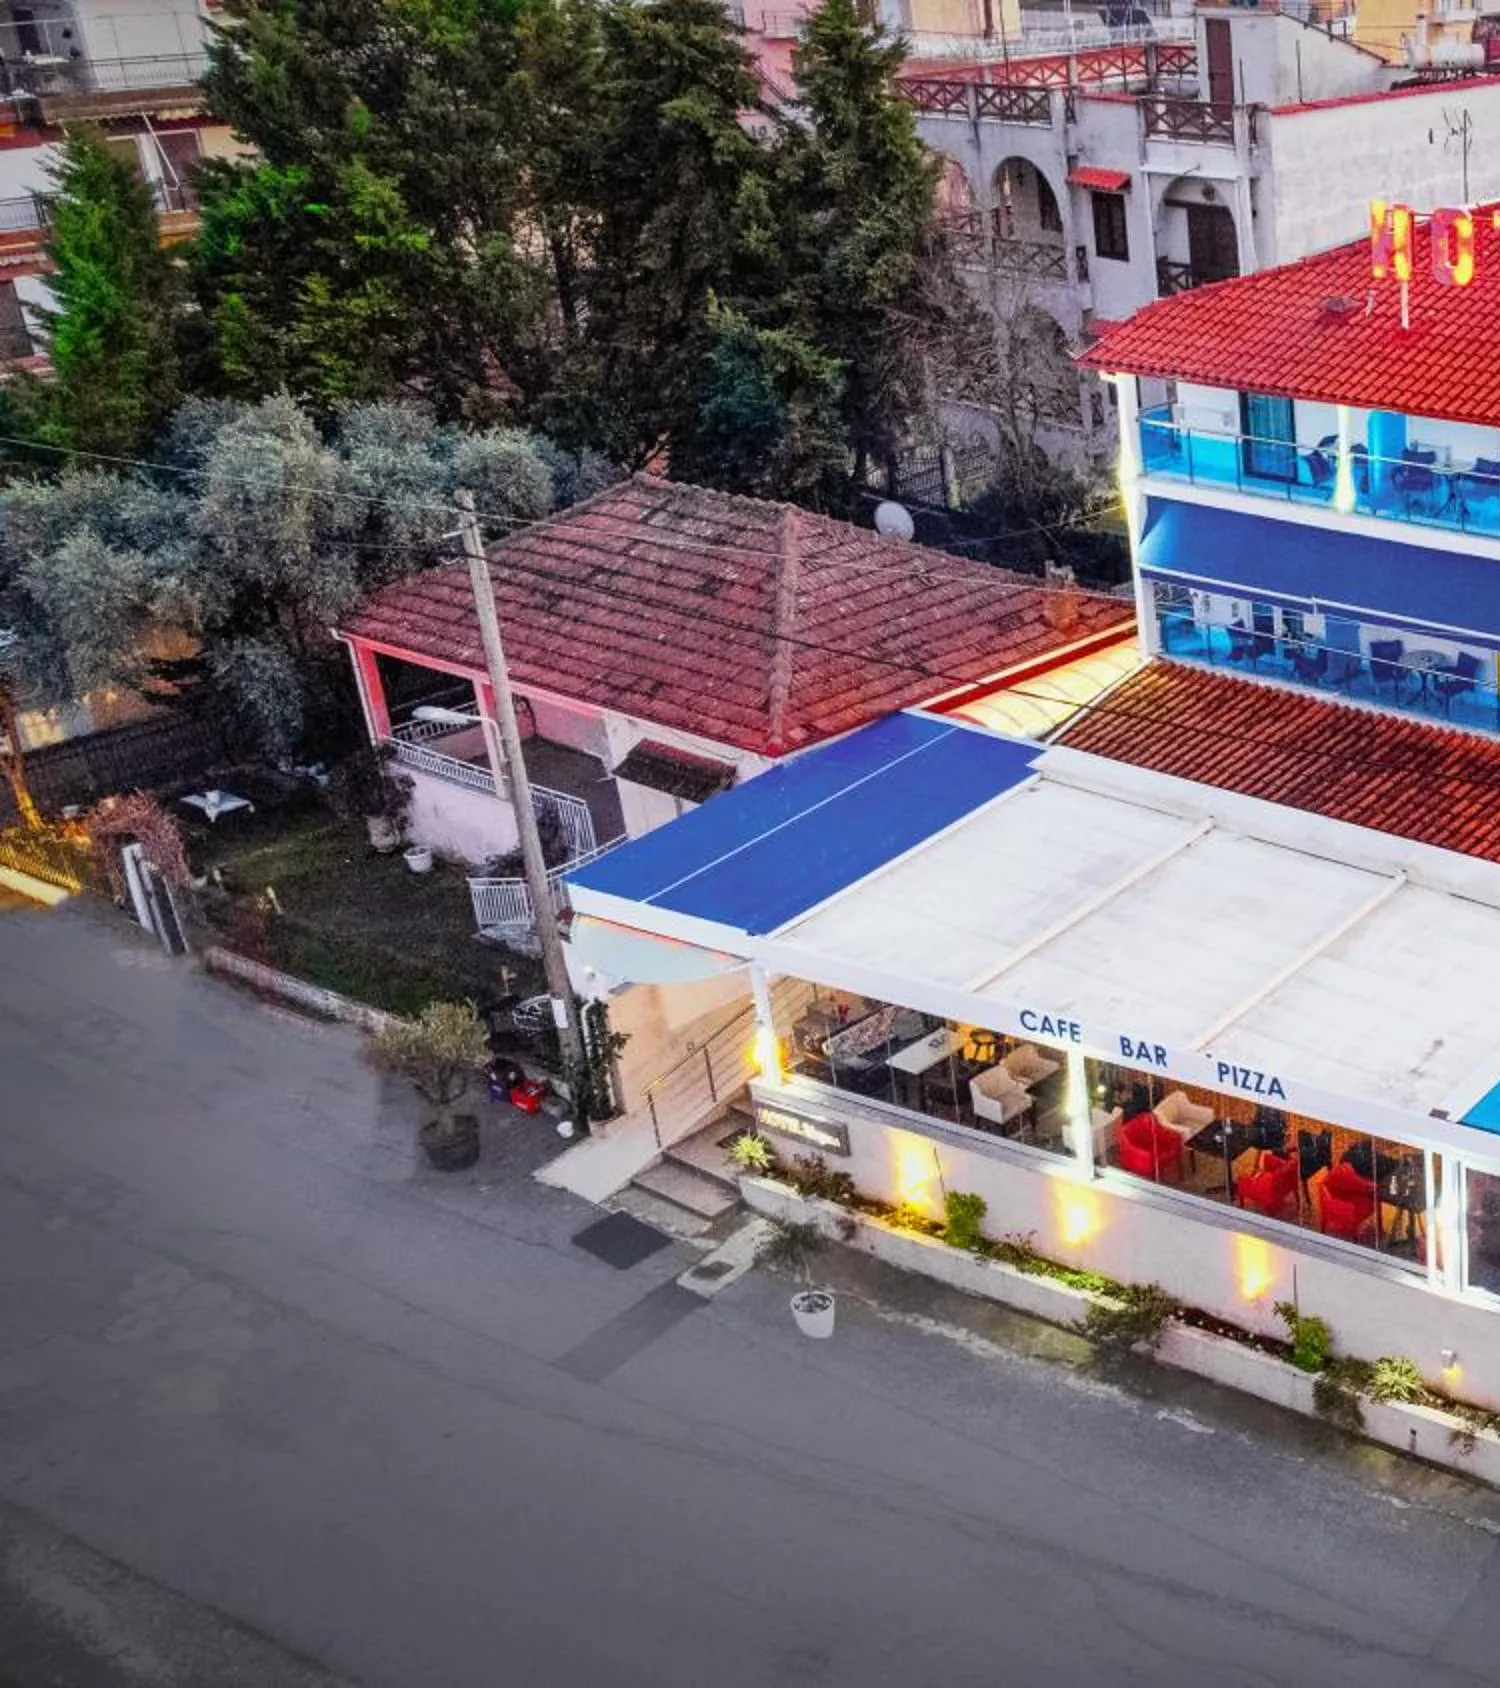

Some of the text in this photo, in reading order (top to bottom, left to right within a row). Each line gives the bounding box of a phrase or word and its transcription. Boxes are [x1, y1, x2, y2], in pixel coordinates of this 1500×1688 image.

[1019, 1009, 1286, 1100] CAFE BAR PIZZA
